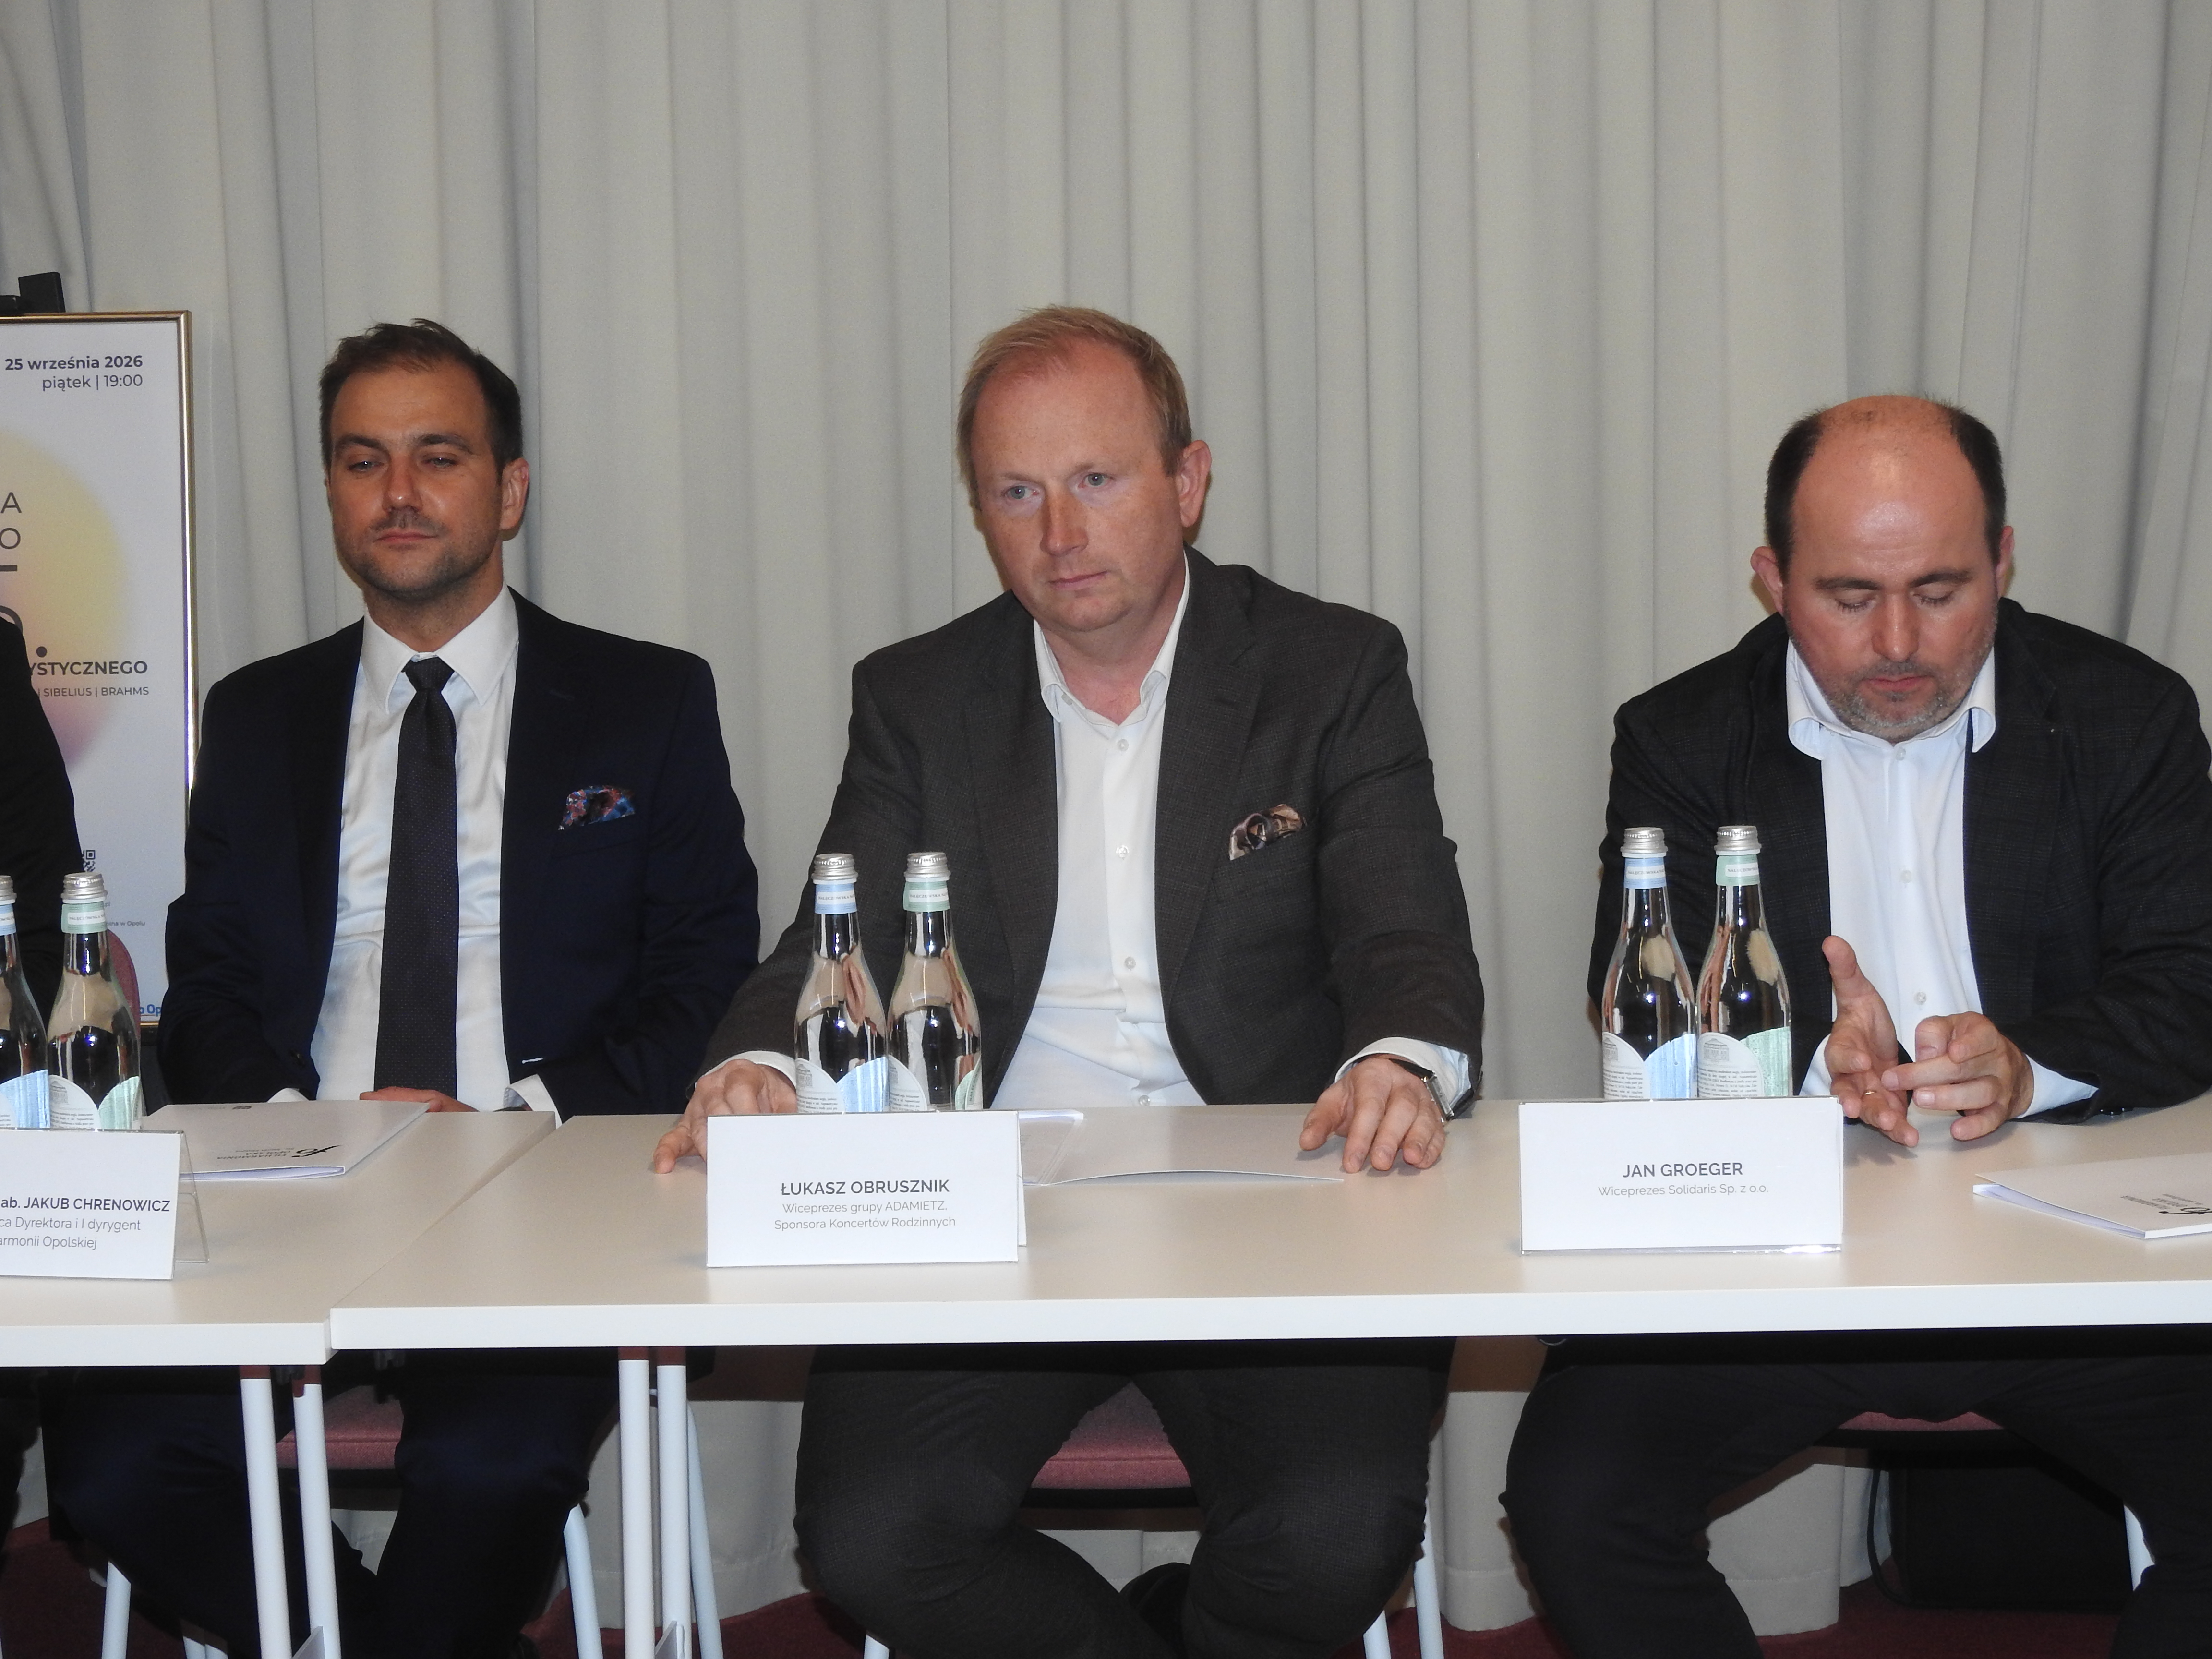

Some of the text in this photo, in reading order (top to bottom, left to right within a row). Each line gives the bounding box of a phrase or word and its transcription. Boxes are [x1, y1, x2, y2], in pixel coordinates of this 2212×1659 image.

[5, 355, 143, 371] 25 września 2026
[42, 375, 91, 392] piątek
[103, 374, 143, 387] 19:00
[0, 492, 22, 514] A
[0, 527, 21, 550] O
[43, 687, 92, 697] SIBELIUS
[101, 686, 149, 697] BRAHMS
[1623, 1162, 1743, 1178] JAN GROEGER
[781, 1179, 950, 1196] ŁUKASZ OBRUSZNIK
[1598, 1183, 1769, 1198] Wiceprezes Solidaris Sp. z o.o.
[24, 1197, 70, 1209] JAKUB
[73, 1198, 170, 1212] CHRENOWICZ
[782, 1203, 847, 1215] Wiceprezes
[850, 1203, 883, 1215] grupy
[15, 1216, 72, 1231] Dyrektora
[75, 1218, 78, 1229] i
[87, 1218, 141, 1233] dyrygent
[774, 1216, 956, 1232] Sponsora Koncertów Rodzinnych
[43, 1236, 97, 1250] Opolskiej
